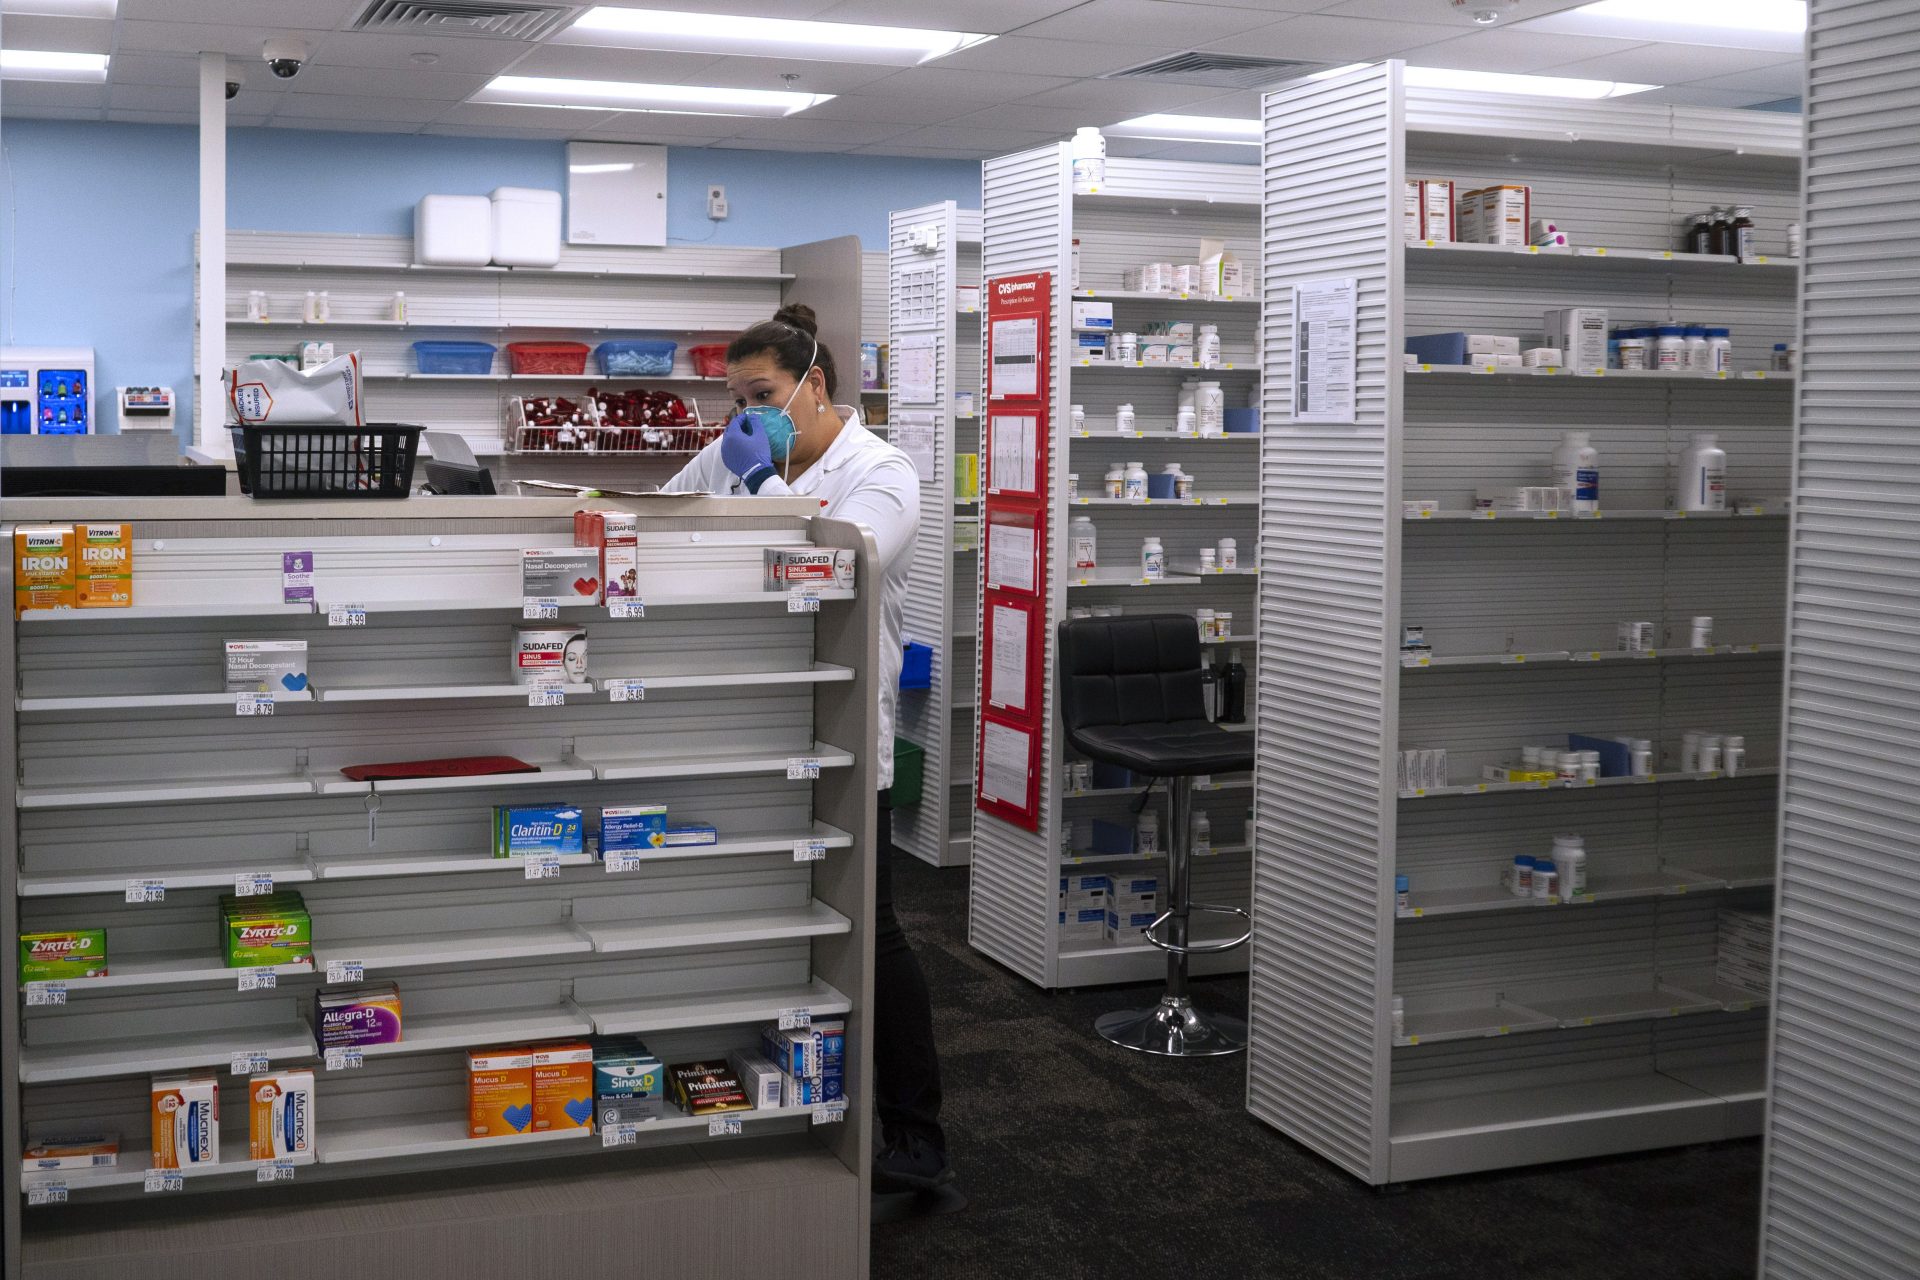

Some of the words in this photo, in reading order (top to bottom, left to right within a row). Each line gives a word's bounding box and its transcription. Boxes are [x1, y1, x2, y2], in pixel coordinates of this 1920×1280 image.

[82, 548, 126, 560] IRON
[22, 557, 68, 570] IRON
[626, 607, 642, 617] $6.99
[346, 615, 364, 625] $6.99
[254, 704, 272, 715] $8.79
[512, 823, 562, 836] Claritin-D
[240, 925, 297, 938] ZYRTEC-D
[31, 938, 91, 952] ZYRTEC-D
[323, 1008, 374, 1022] Allegra-D
[366, 1019, 375, 1027] 12
[677, 1068, 725, 1078] Primatene
[688, 1079, 736, 1091] Primatene
[266, 1089, 272, 1098] 12
[169, 1098, 175, 1107] 12
